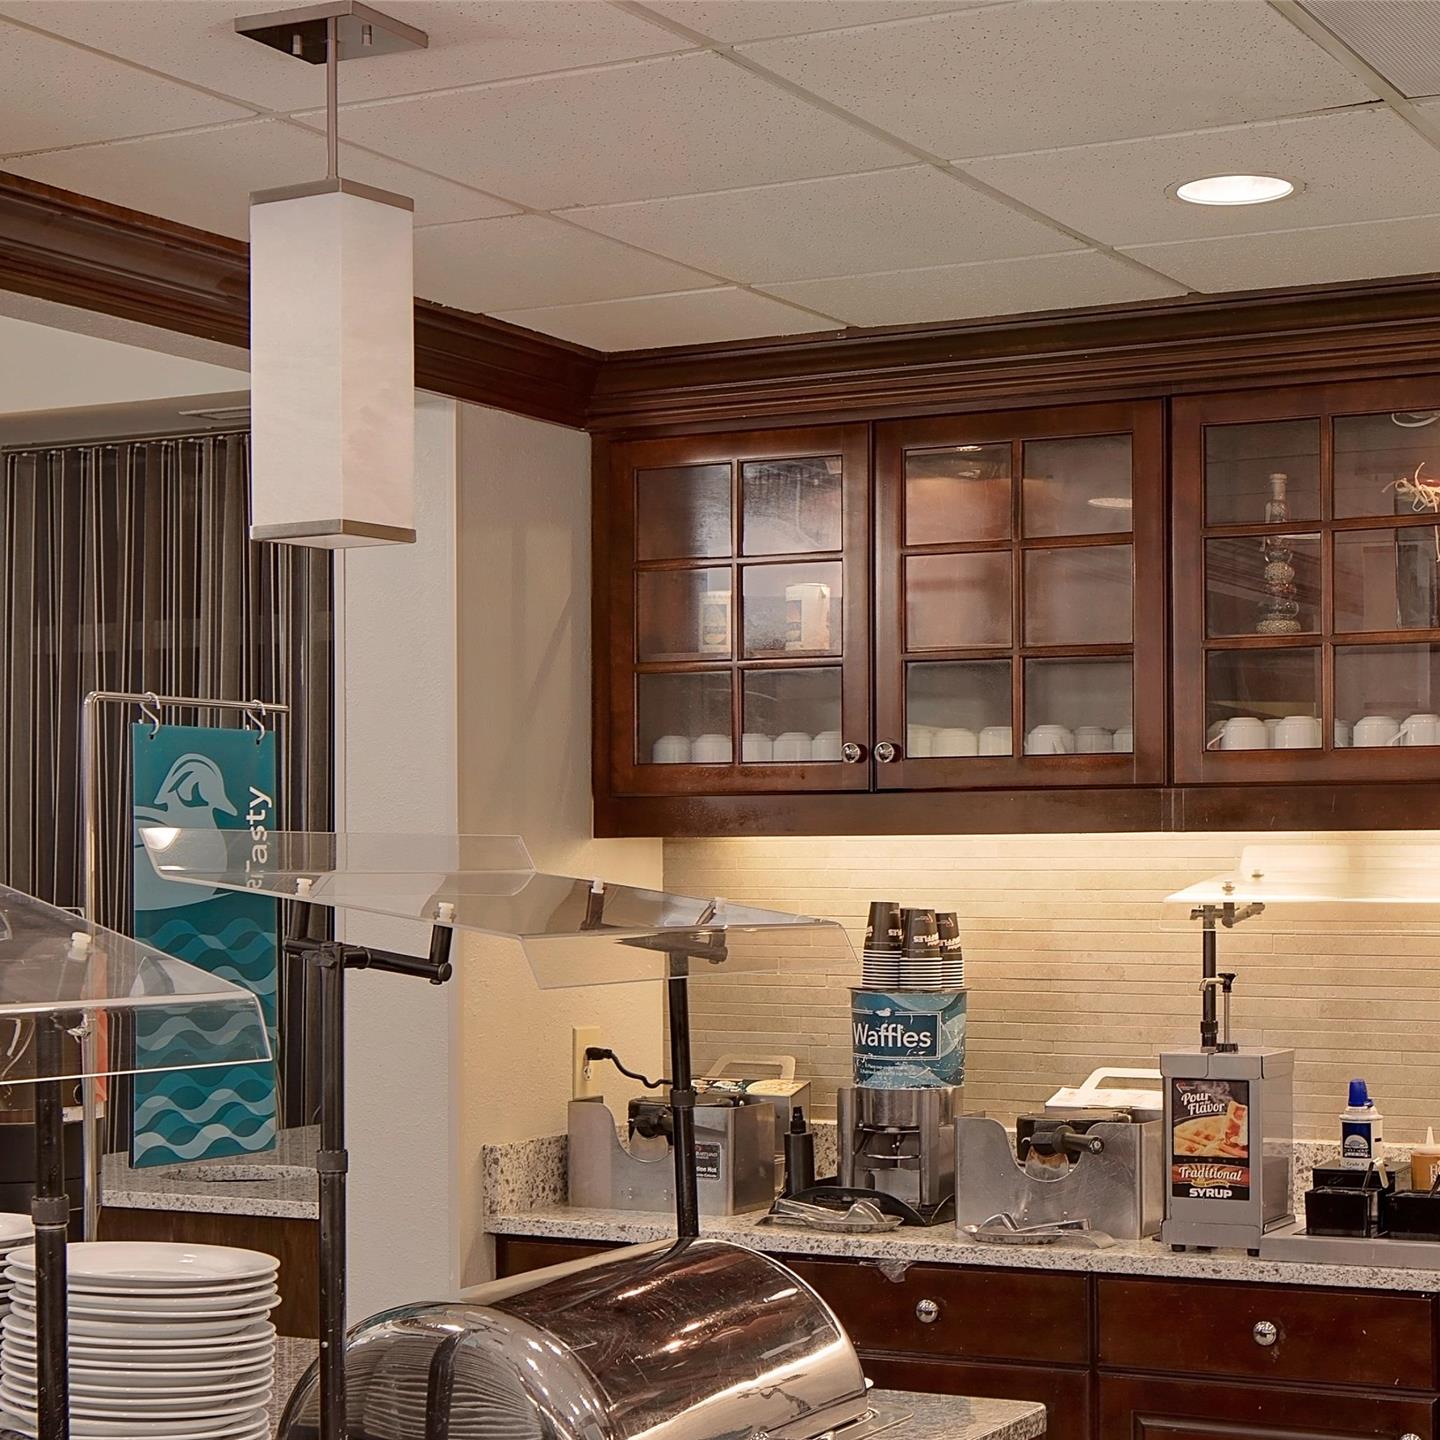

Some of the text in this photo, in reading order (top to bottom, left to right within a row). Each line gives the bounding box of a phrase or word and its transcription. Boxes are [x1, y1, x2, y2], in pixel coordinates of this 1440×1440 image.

[852, 1022, 932, 1048] Waffles
[1181, 1092, 1211, 1106] Pour
[1187, 1103, 1225, 1116] Flavor
[1178, 1166, 1243, 1181] Traditional
[1189, 1188, 1233, 1199] SYRUP
